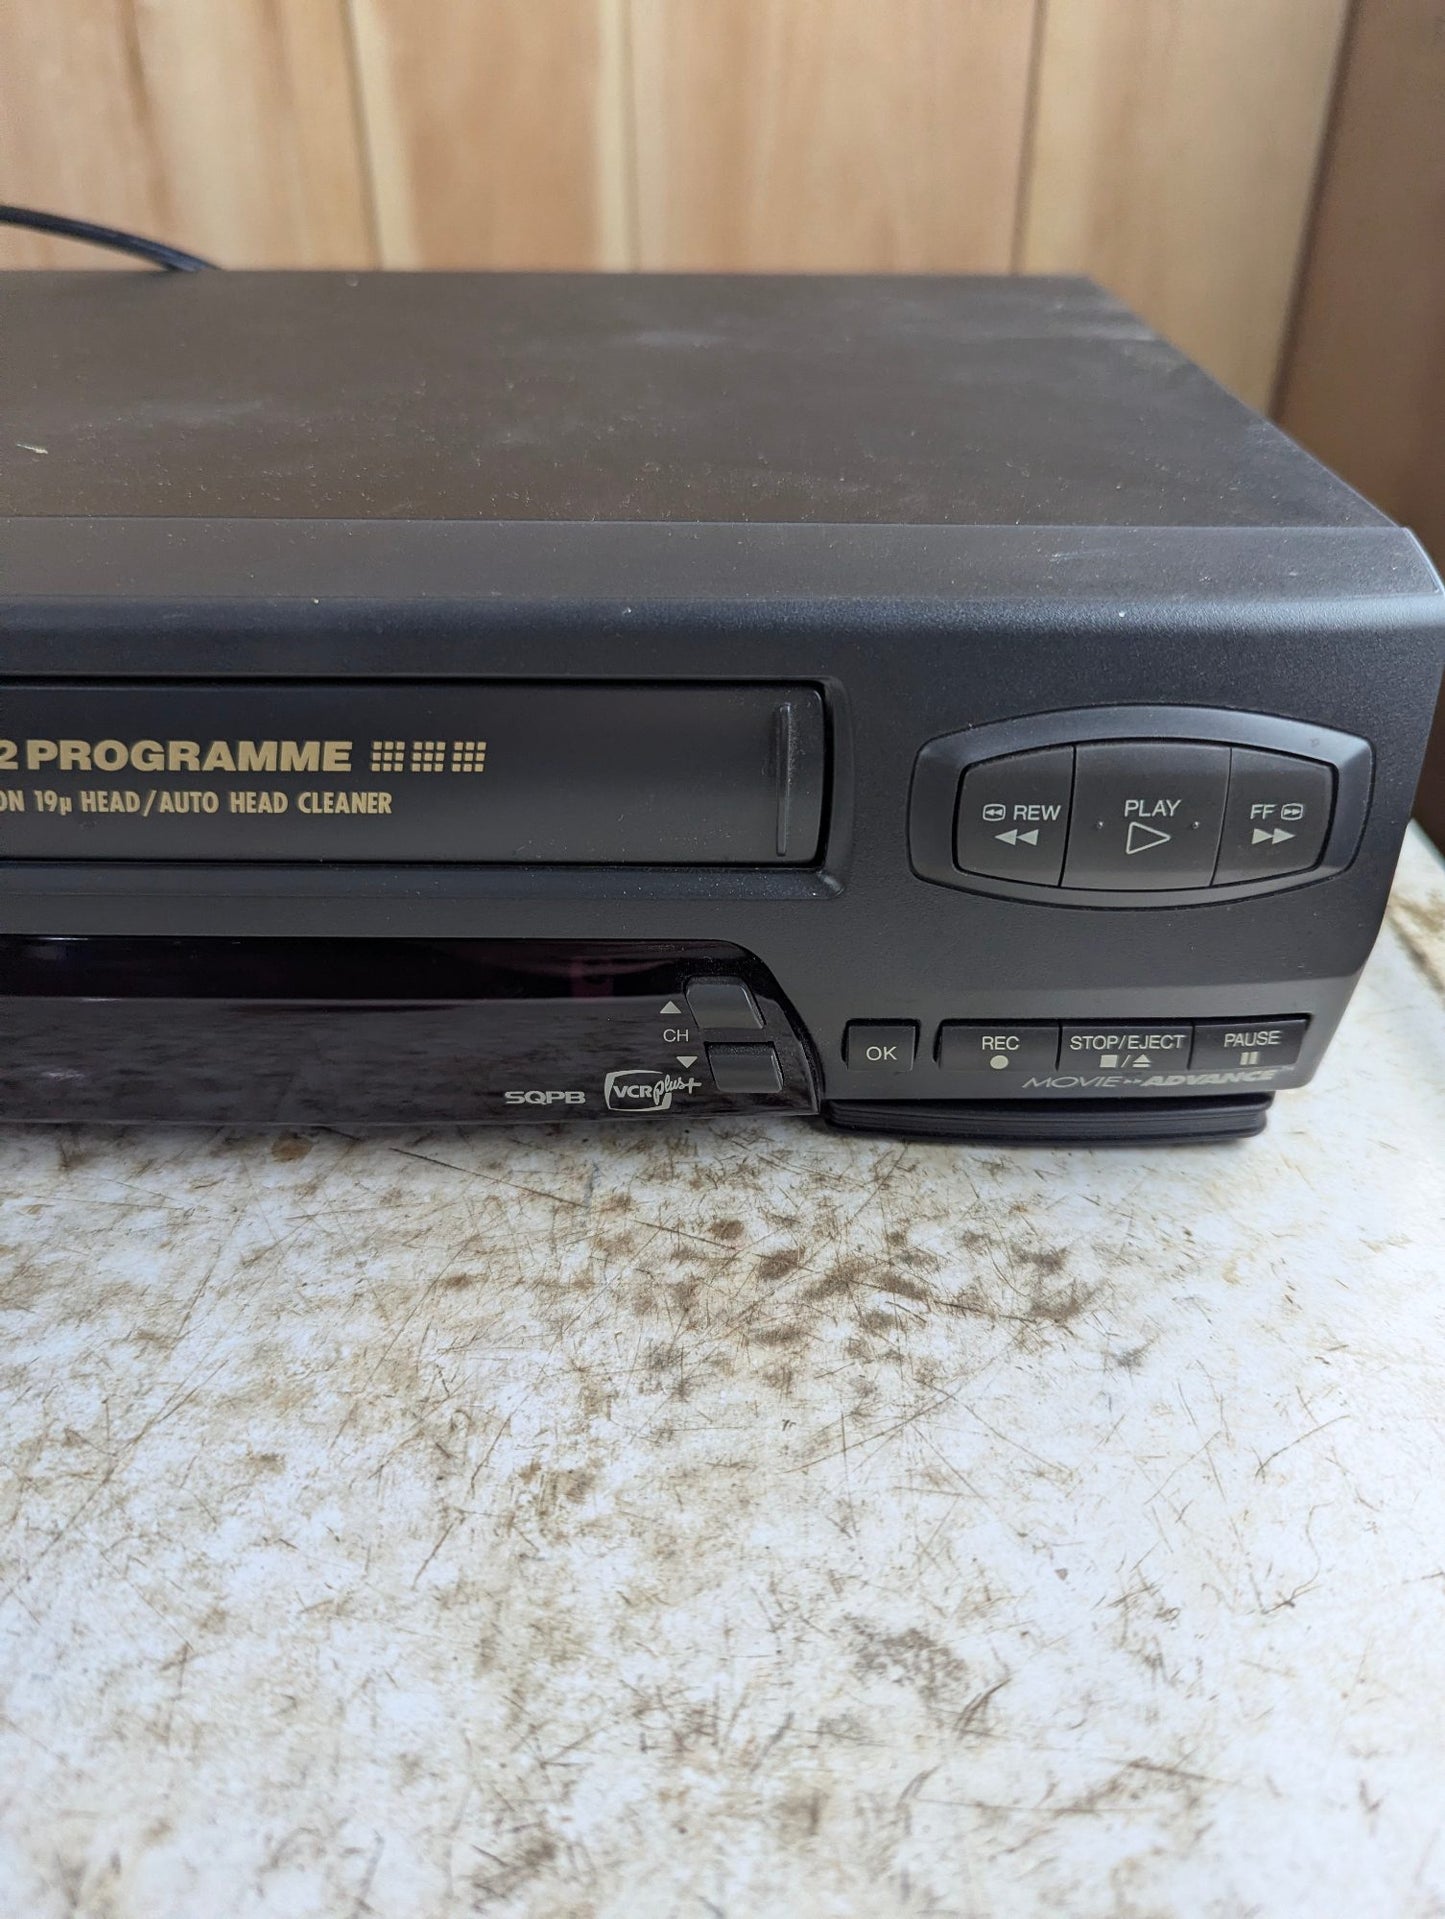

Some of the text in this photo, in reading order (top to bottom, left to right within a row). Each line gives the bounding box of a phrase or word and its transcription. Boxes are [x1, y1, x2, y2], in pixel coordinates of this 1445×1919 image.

[0, 739, 353, 772] 2 PROGRAMME
[80, 789, 219, 816] HEAD/AUTO
[230, 791, 289, 814] HEAD
[298, 792, 393, 815] CLEANER
[1124, 799, 1181, 818] PLAY
[1013, 804, 1061, 821] REW
[1250, 803, 1276, 820] FF
[662, 1029, 690, 1043] CH
[981, 1036, 1020, 1051] REC
[1070, 1034, 1187, 1051] STOP/EJECT
[1223, 1030, 1282, 1048] PAUSE
[865, 1046, 898, 1062] OK
[1021, 1075, 1125, 1090] MOVIE
[1140, 1067, 1280, 1088] ADVANCE
[504, 1090, 587, 1106] SQPB
[612, 1084, 653, 1099] VCR
